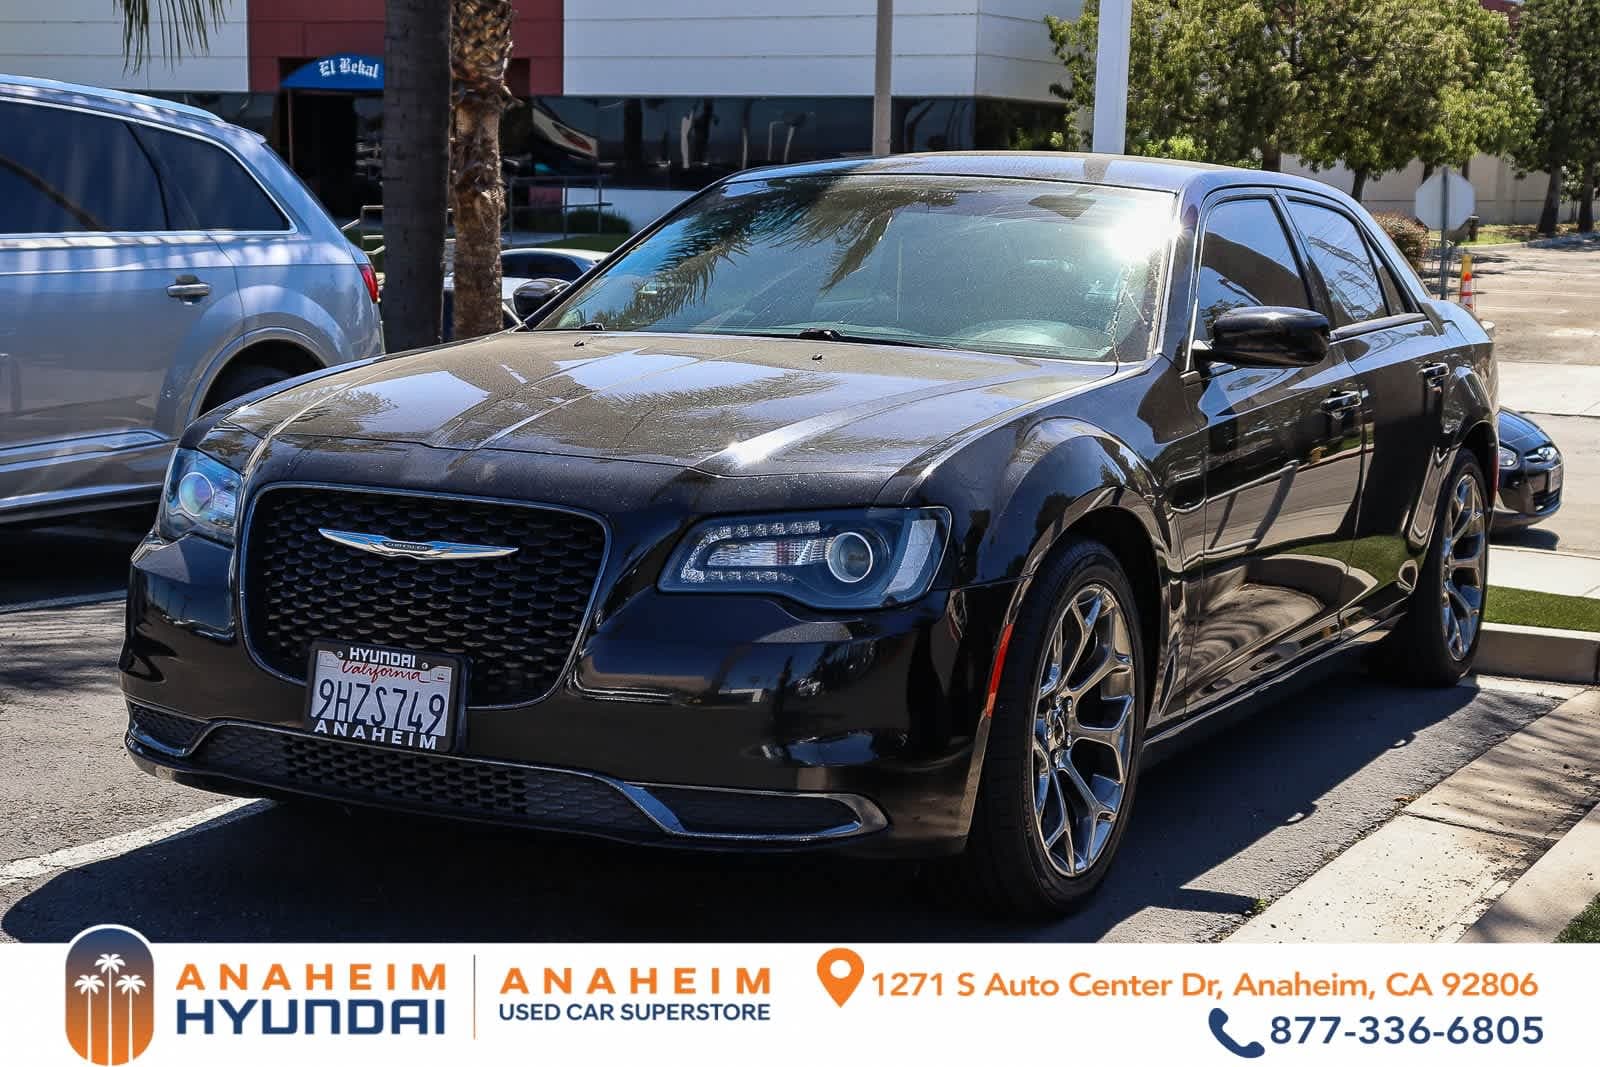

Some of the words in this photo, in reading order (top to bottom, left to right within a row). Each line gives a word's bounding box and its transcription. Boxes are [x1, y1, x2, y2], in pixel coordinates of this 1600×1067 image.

[319, 59, 336, 77] El
[349, 647, 417, 669] HYUNDAI
[341, 659, 431, 684] California
[313, 678, 446, 735] 9HZS749
[314, 719, 437, 750] ANAHEIM
